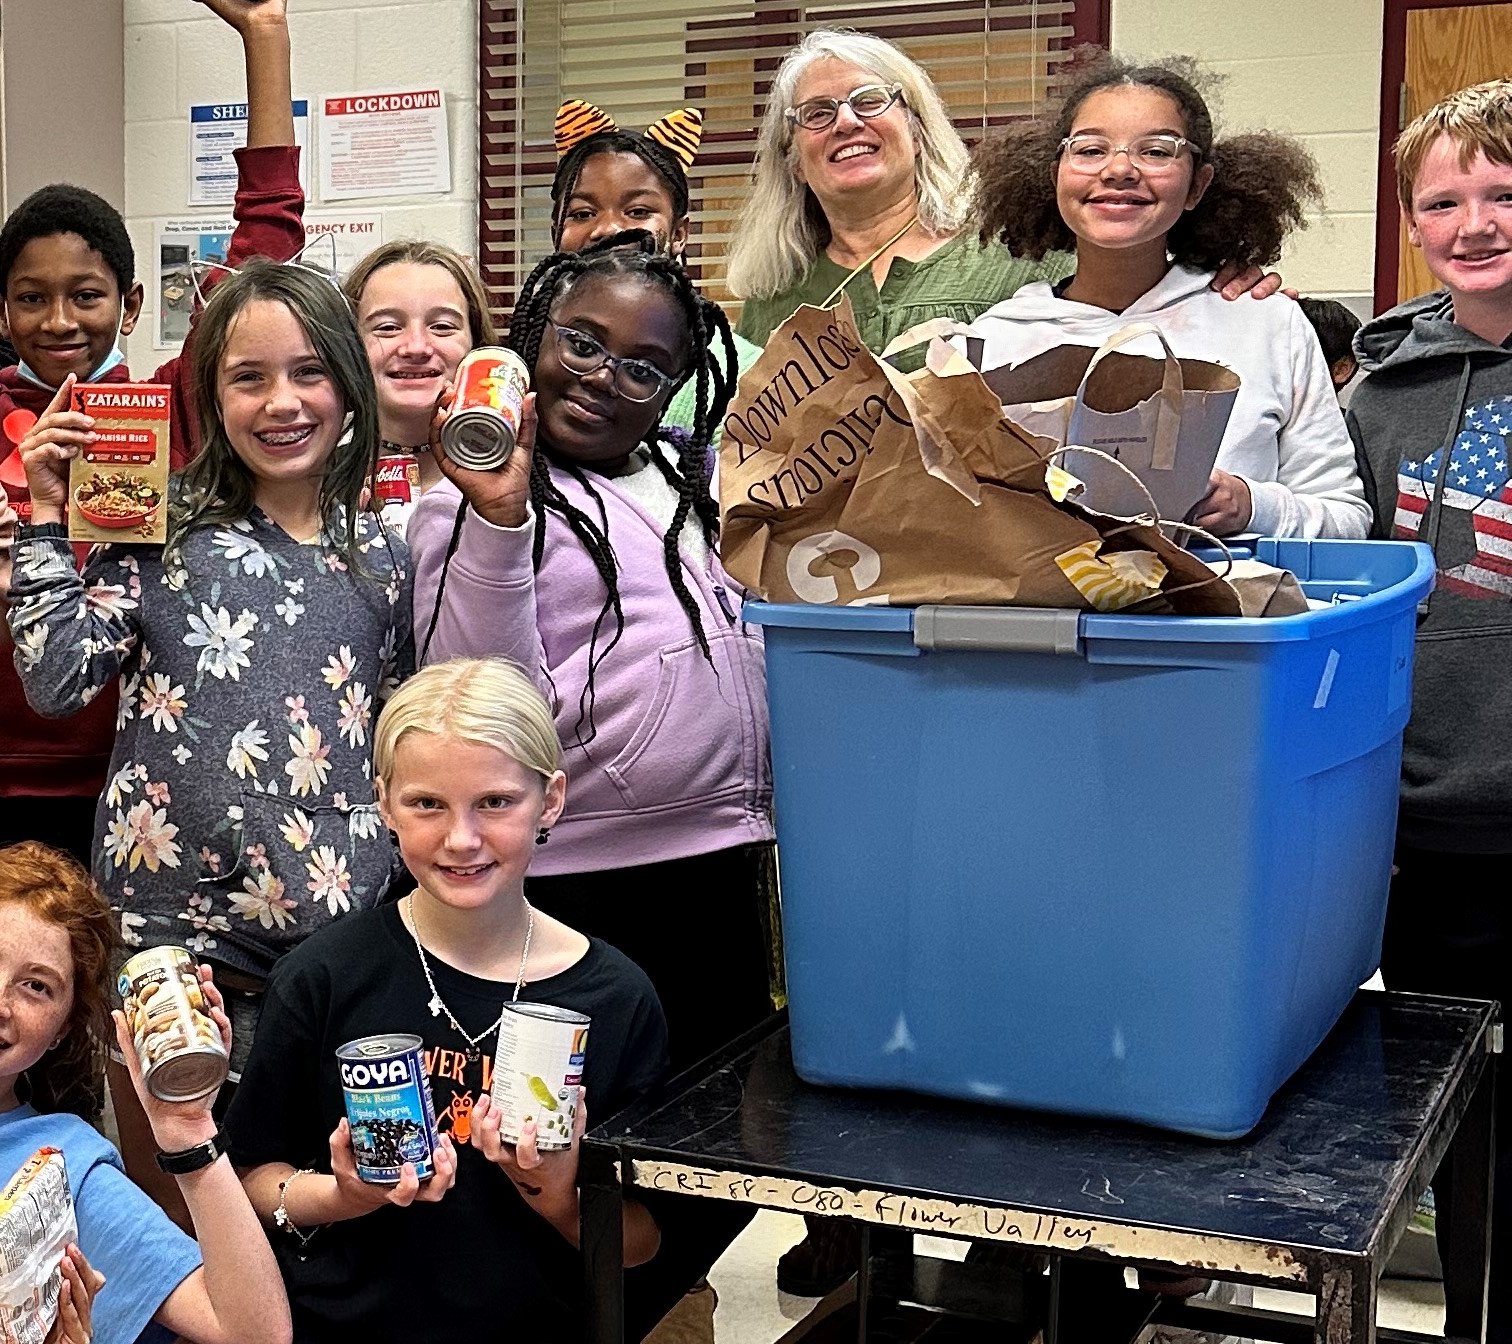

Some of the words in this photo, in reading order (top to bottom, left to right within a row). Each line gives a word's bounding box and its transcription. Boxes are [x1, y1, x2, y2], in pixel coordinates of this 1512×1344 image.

[345, 93, 439, 113] LOCKDOWN
[305, 223, 346, 235] GENCY
[349, 222, 375, 233] EXIT
[86, 393, 166, 408] ZATARAIN'S
[95, 433, 127, 443] PANISH
[341, 1060, 408, 1087] GOYA
[875, 1194, 962, 1228] Flower
